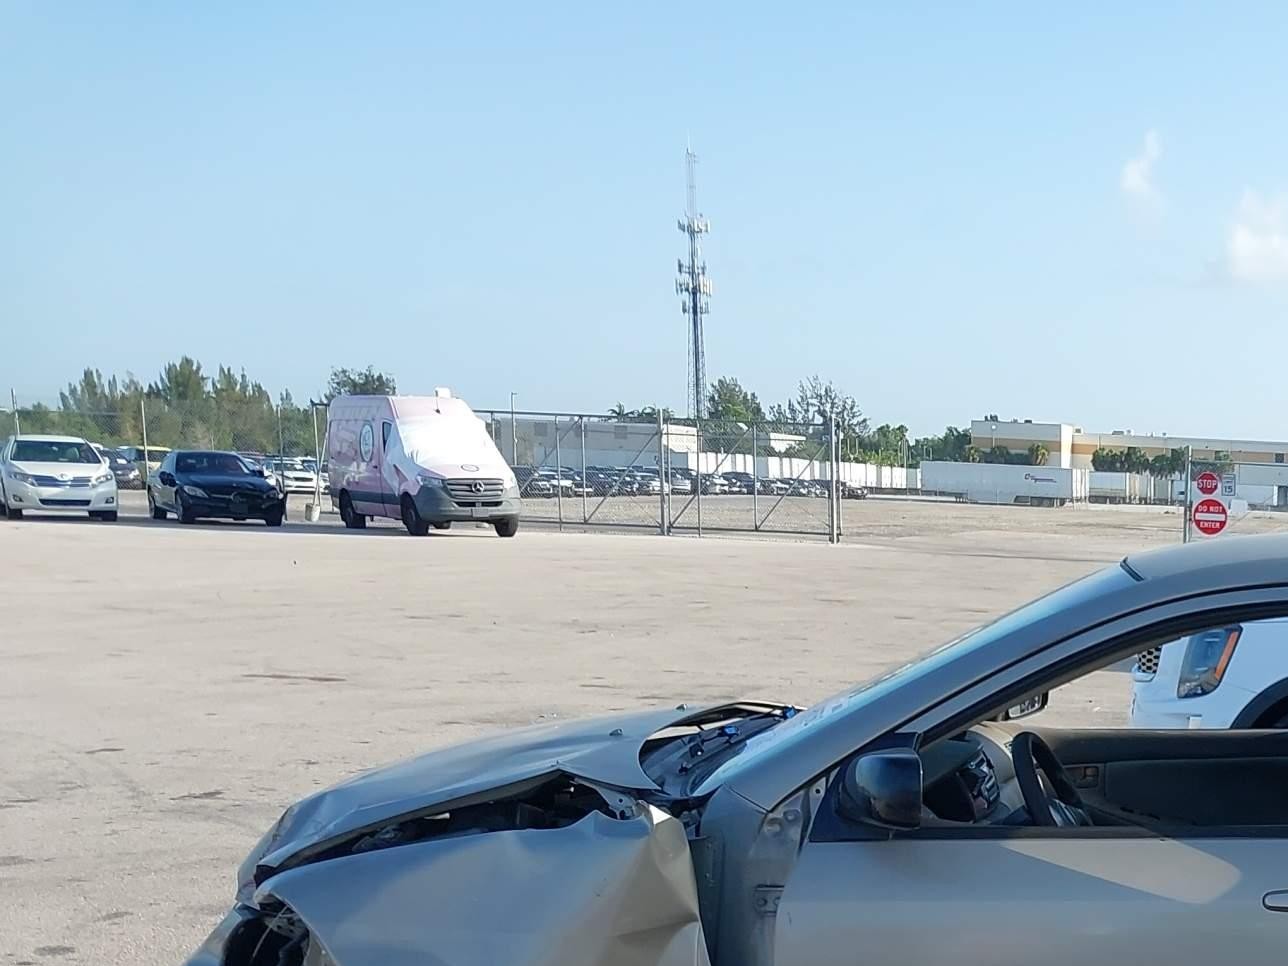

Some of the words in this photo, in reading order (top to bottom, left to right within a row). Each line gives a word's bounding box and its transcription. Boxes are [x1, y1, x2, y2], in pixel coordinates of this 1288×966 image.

[1198, 480, 1217, 489] STOP
[1225, 485, 1233, 493] 15
[1200, 521, 1220, 529] ENTER
